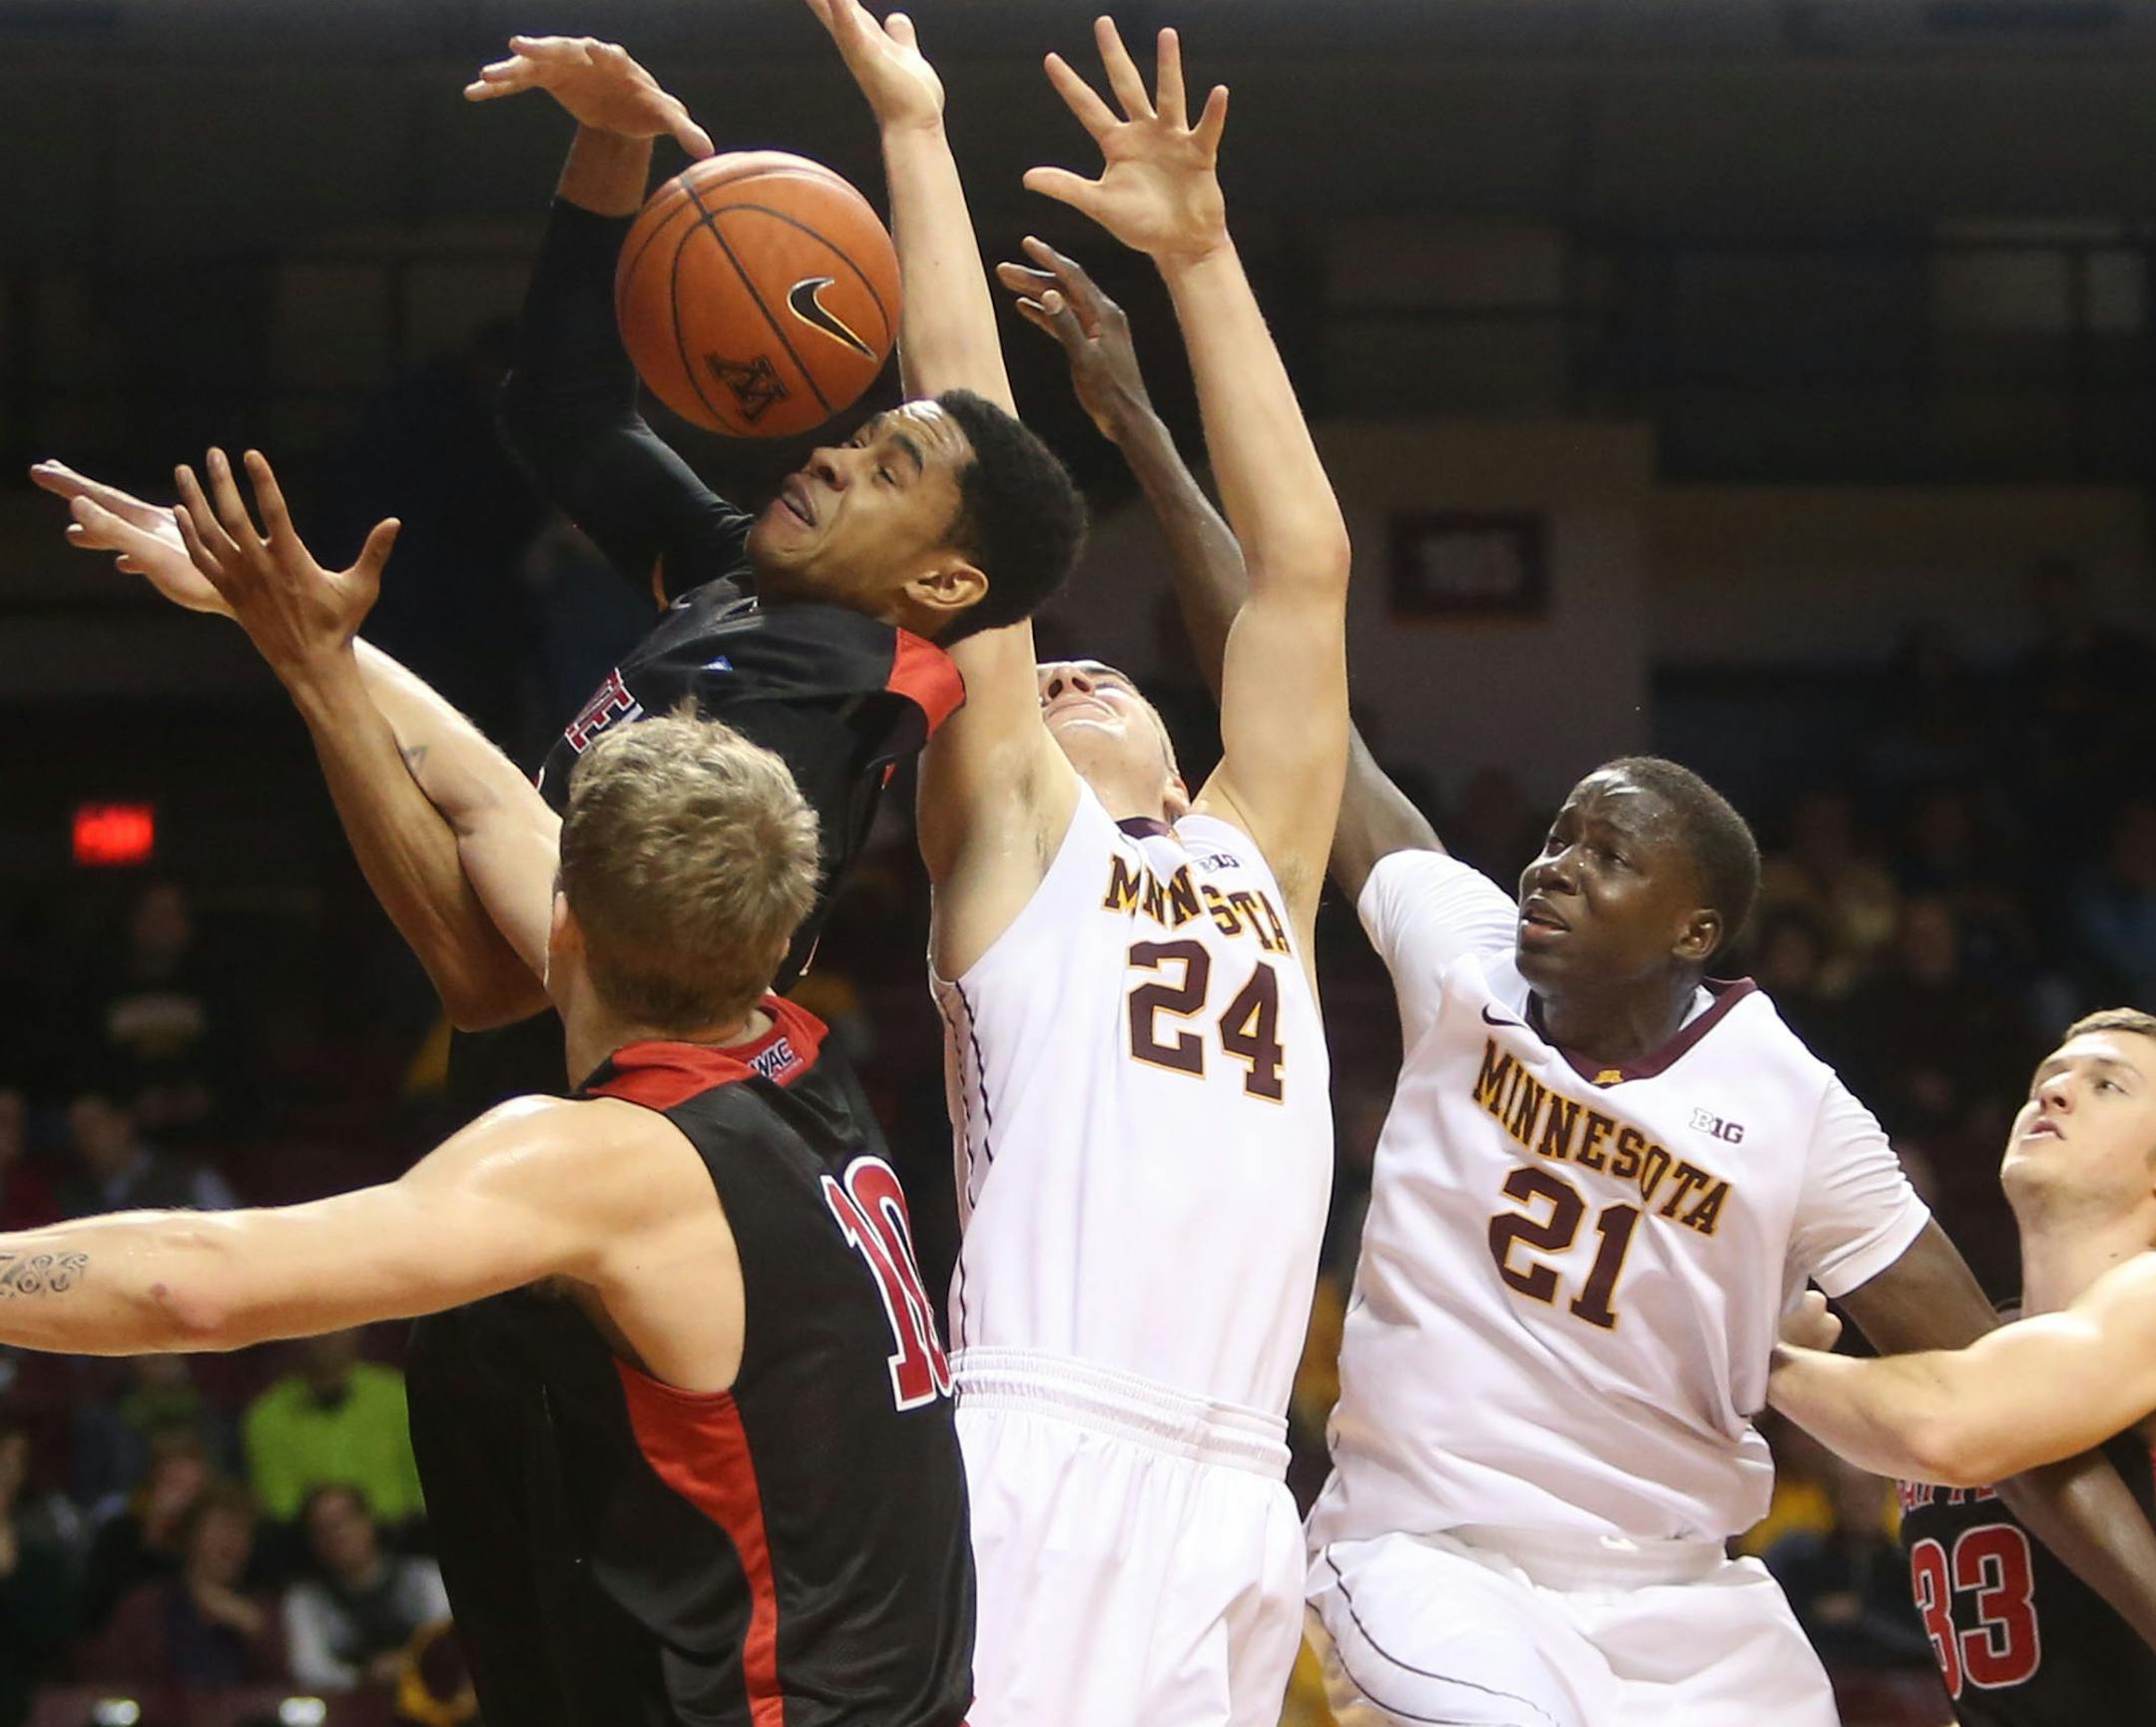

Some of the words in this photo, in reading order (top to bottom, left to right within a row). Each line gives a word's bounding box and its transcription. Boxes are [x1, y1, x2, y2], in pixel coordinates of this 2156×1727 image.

[1128, 938, 1285, 1105] 24
[1471, 1035, 1735, 1237] MINNESOTA
[819, 1155, 953, 1413] 10
[1487, 1165, 1643, 1332] 21
[1910, 1523, 2041, 1700] 33
